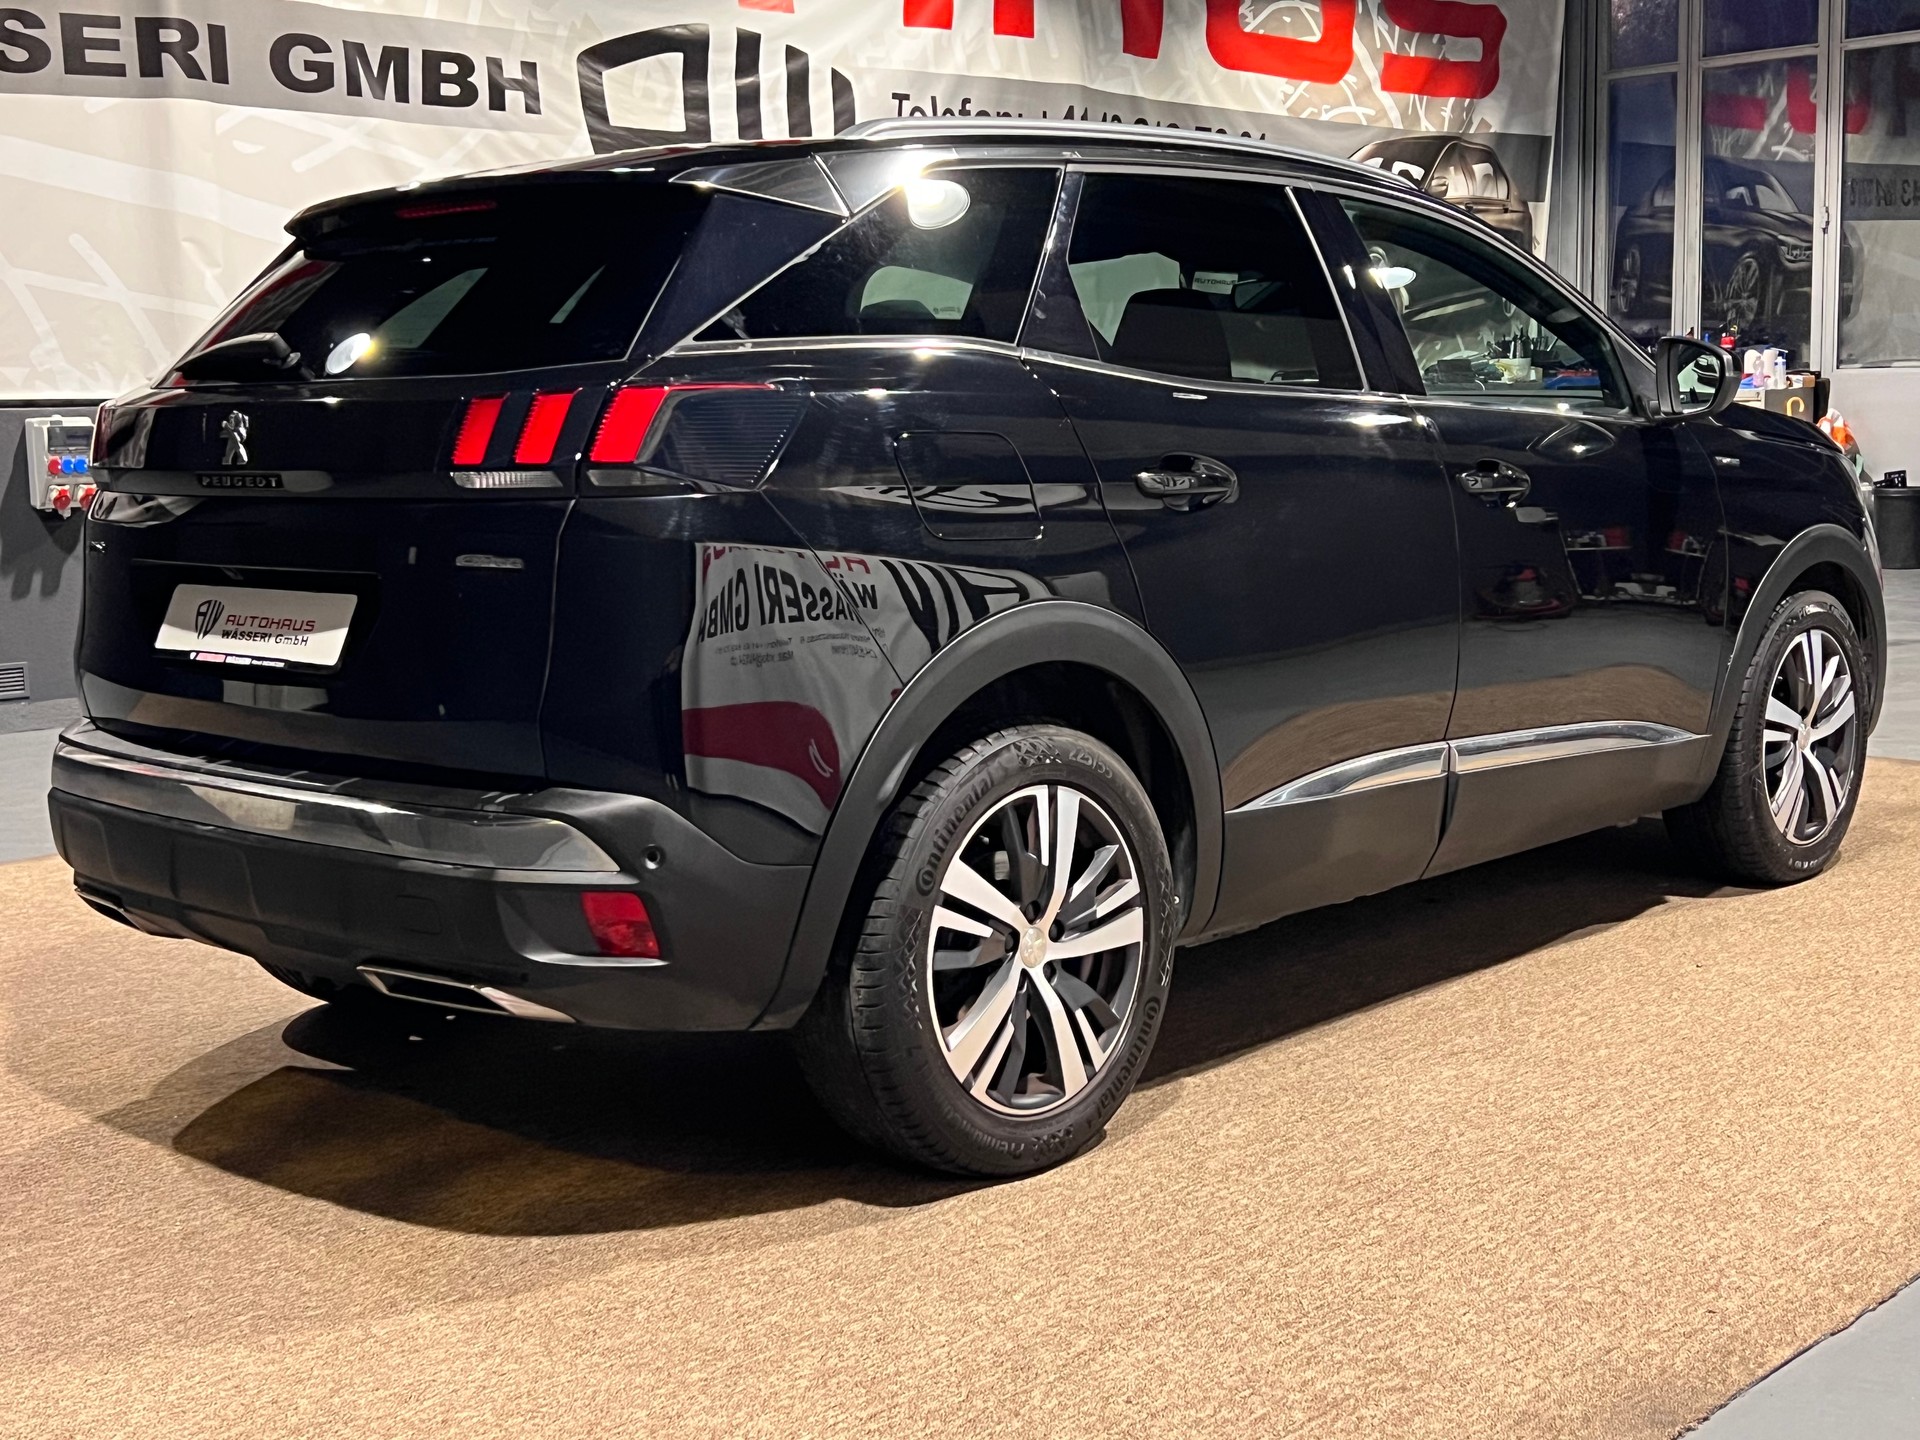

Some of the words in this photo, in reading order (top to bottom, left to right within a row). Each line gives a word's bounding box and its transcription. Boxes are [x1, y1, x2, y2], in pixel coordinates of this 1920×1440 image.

[269, 32, 543, 116] GMBH
[202, 475, 278, 488] PEUGEOT
[225, 614, 316, 633] AUTOHAUS
[274, 633, 309, 647] GmbH
[915, 772, 996, 897] Continental
[1097, 995, 1162, 1120] Continental
